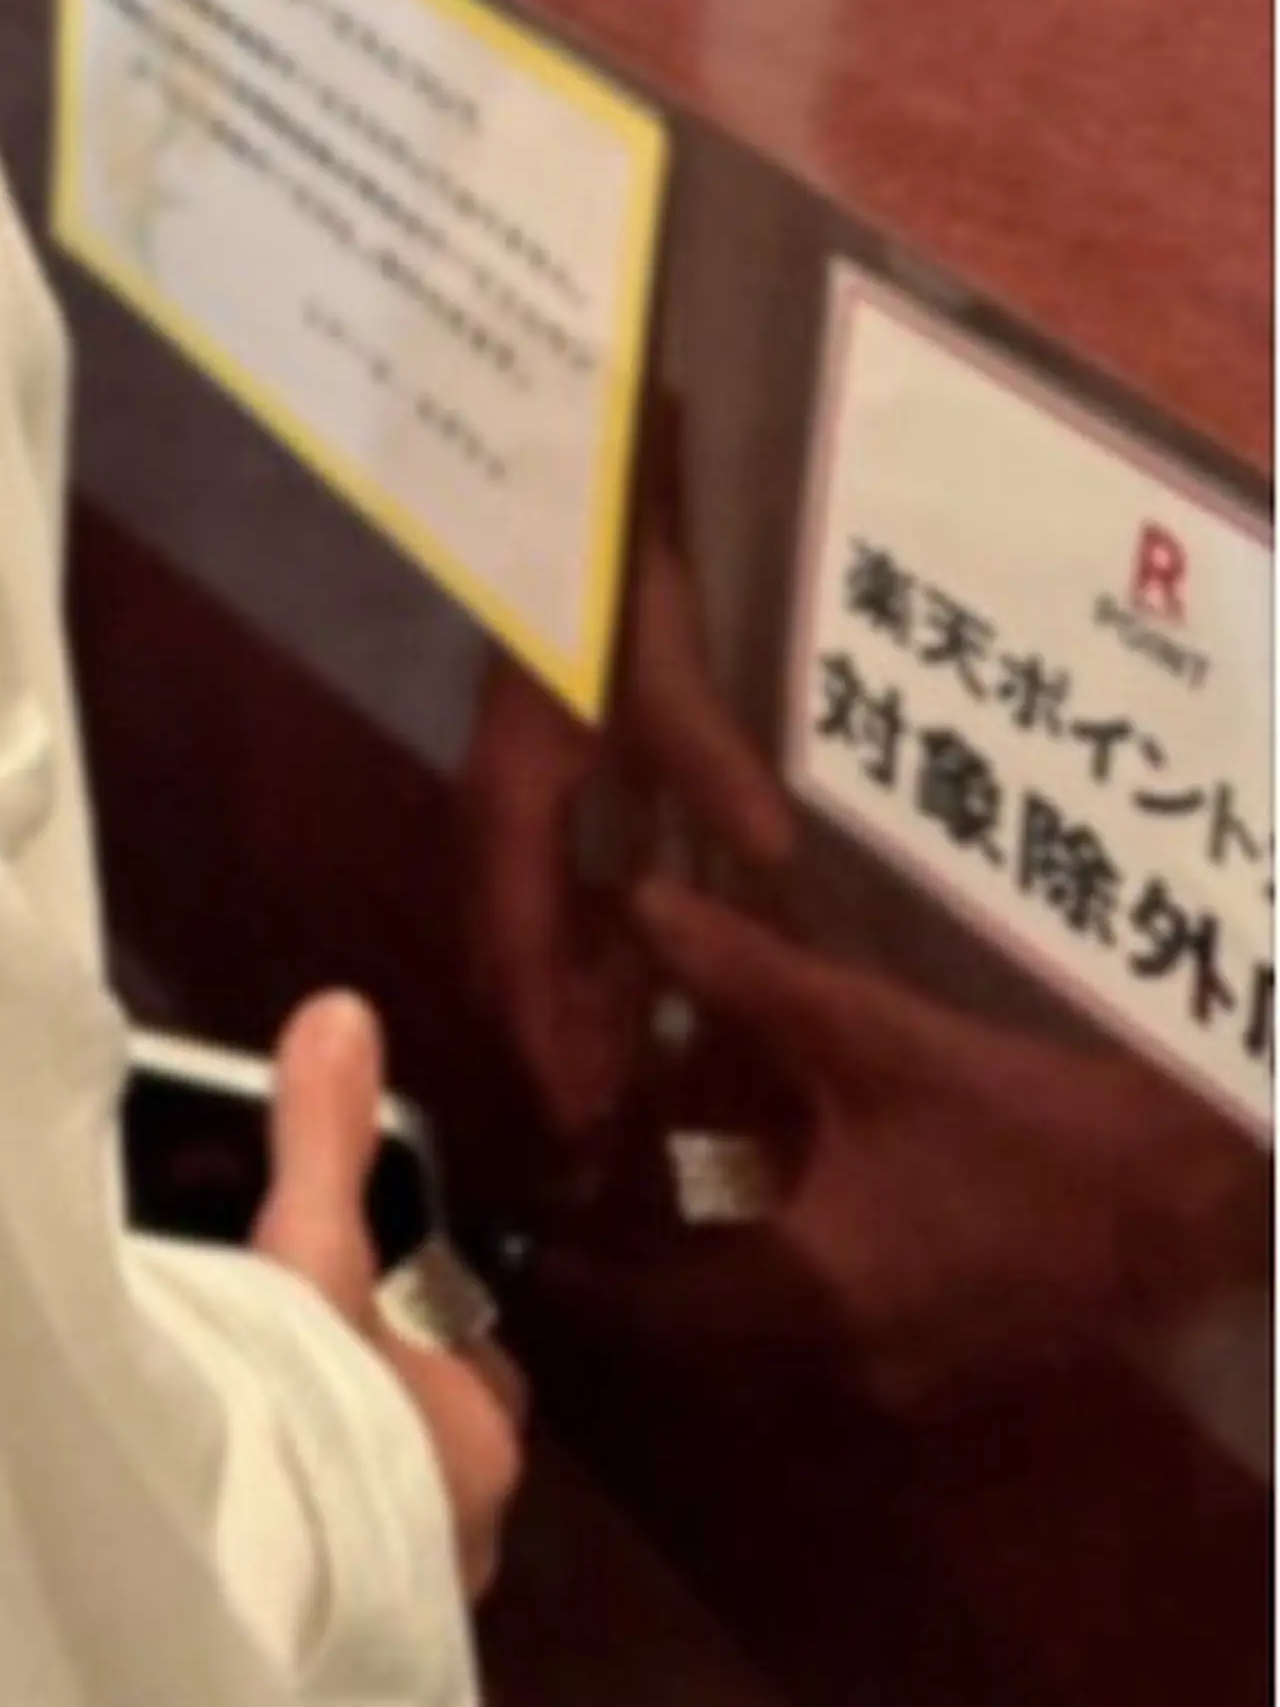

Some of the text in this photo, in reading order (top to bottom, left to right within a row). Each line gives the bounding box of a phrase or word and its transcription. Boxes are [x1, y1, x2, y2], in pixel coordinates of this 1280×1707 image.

[1130, 519, 1188, 623] R
[842, 537, 1274, 903] 楽天ポイント
